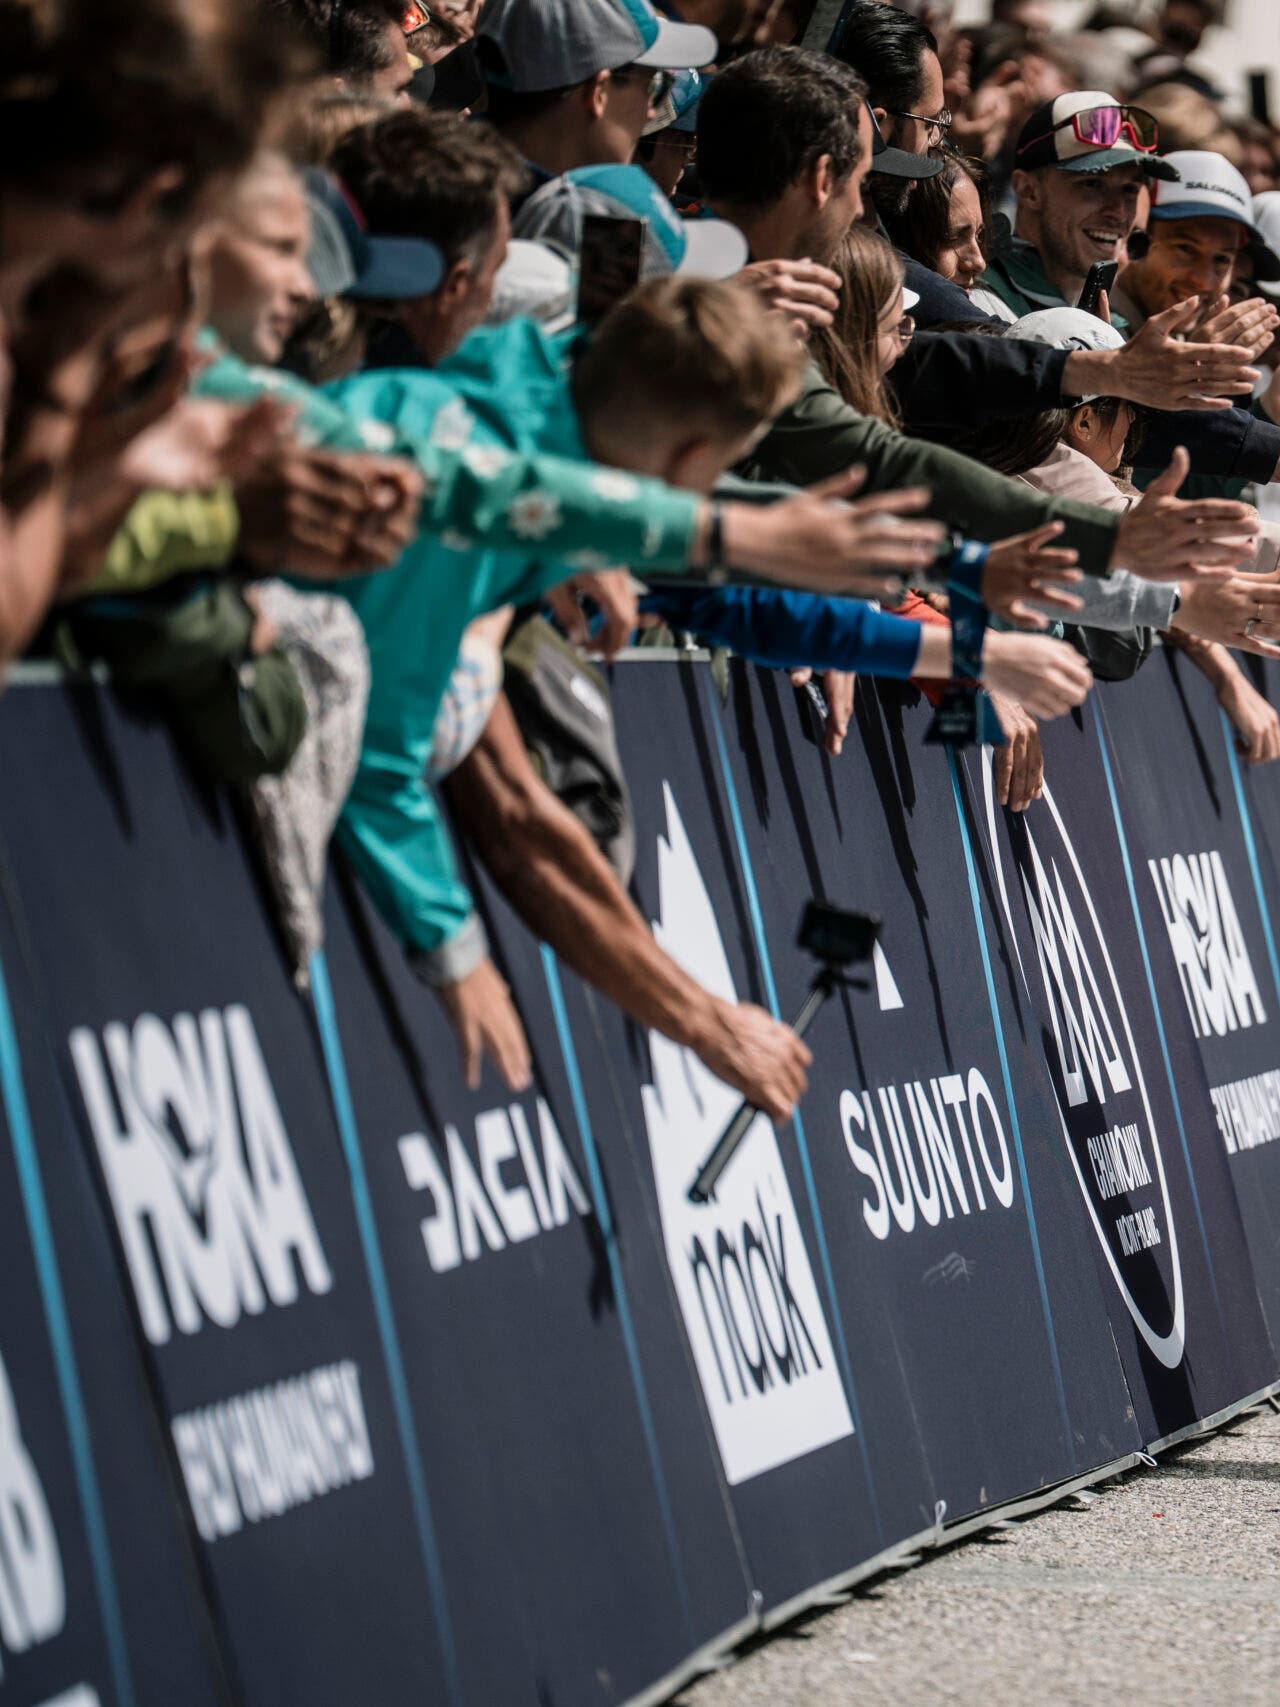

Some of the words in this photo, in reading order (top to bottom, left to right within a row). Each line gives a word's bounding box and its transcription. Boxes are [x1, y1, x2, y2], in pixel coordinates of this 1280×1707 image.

[1148, 851, 1266, 1038] HOKA
[69, 1004, 332, 1345] HOKA
[397, 1096, 591, 1273] DACIA
[840, 1067, 1013, 1240] SUUNTO
[1087, 1123, 1152, 1200] CHAMONIX
[1116, 1206, 1161, 1256] MONT-BLANC
